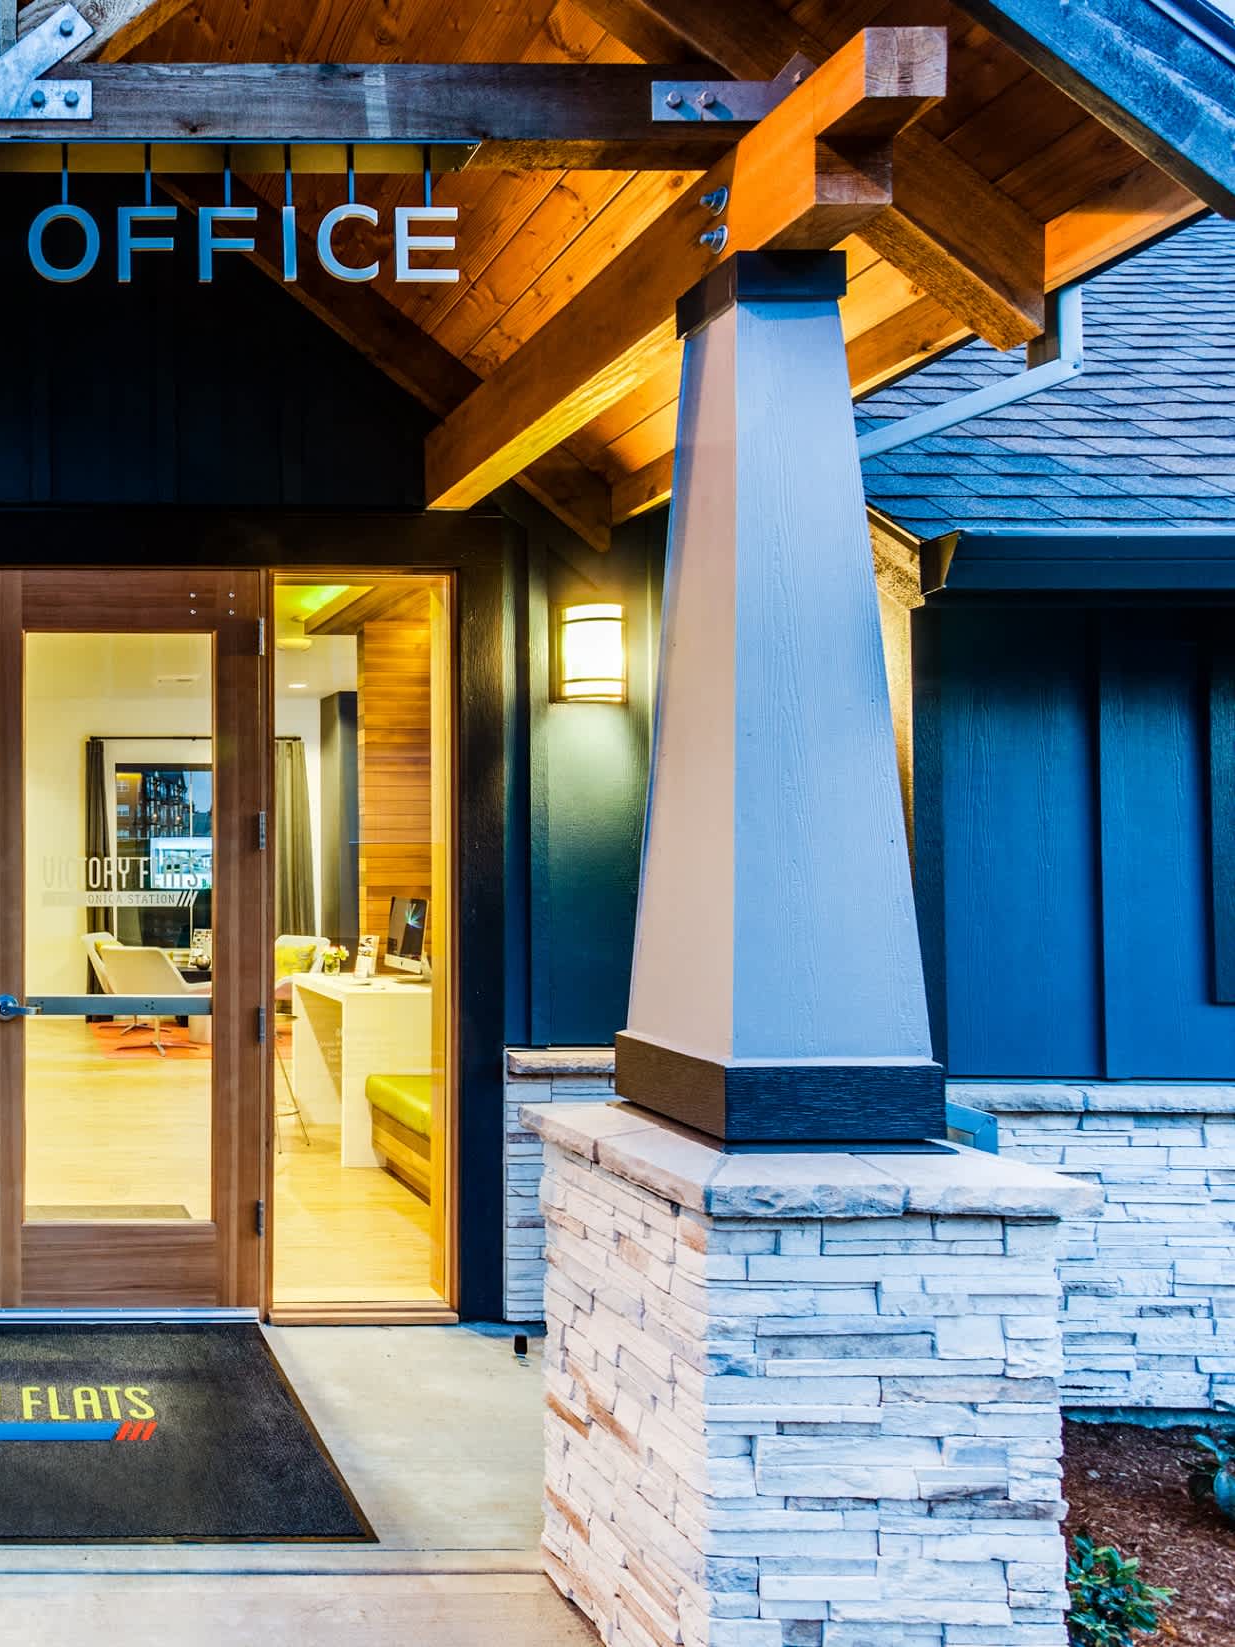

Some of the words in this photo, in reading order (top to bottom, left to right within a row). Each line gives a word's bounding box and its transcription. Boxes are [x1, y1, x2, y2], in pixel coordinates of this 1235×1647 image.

[27, 203, 460, 283] OFFICE
[128, 893, 176, 905] STATION
[21, 1386, 156, 1420] FLATS
